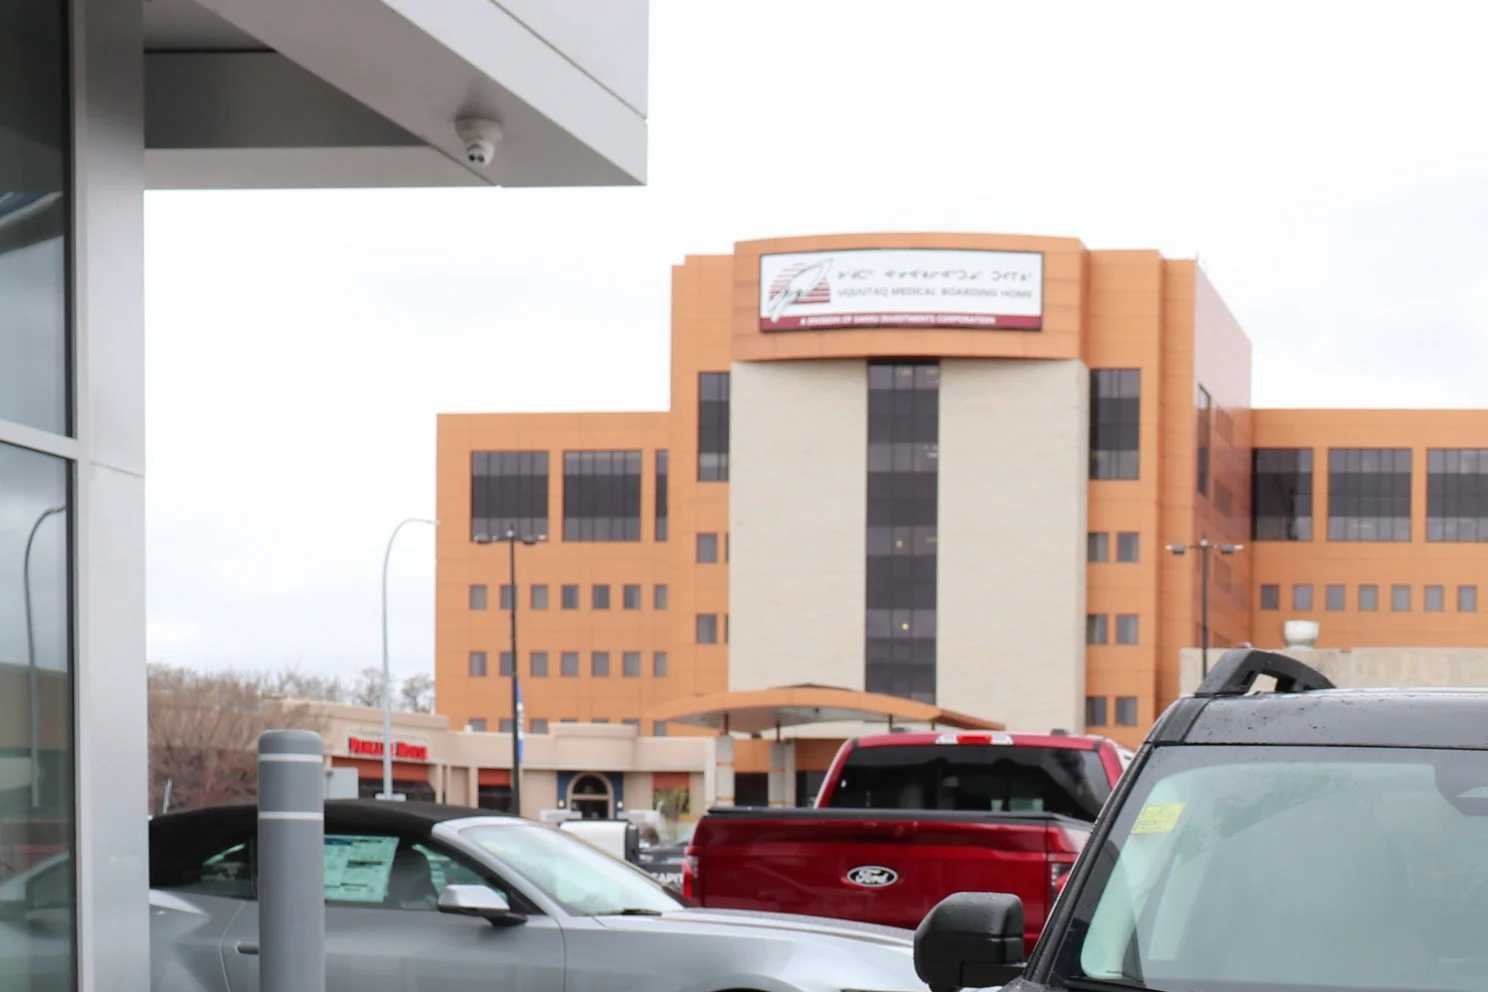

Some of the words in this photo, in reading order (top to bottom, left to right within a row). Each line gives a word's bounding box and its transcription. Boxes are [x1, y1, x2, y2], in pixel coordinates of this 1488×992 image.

[891, 286, 936, 297] MEDICAL
[1000, 288, 1033, 298] HOME
[856, 869, 889, 884] Ford
